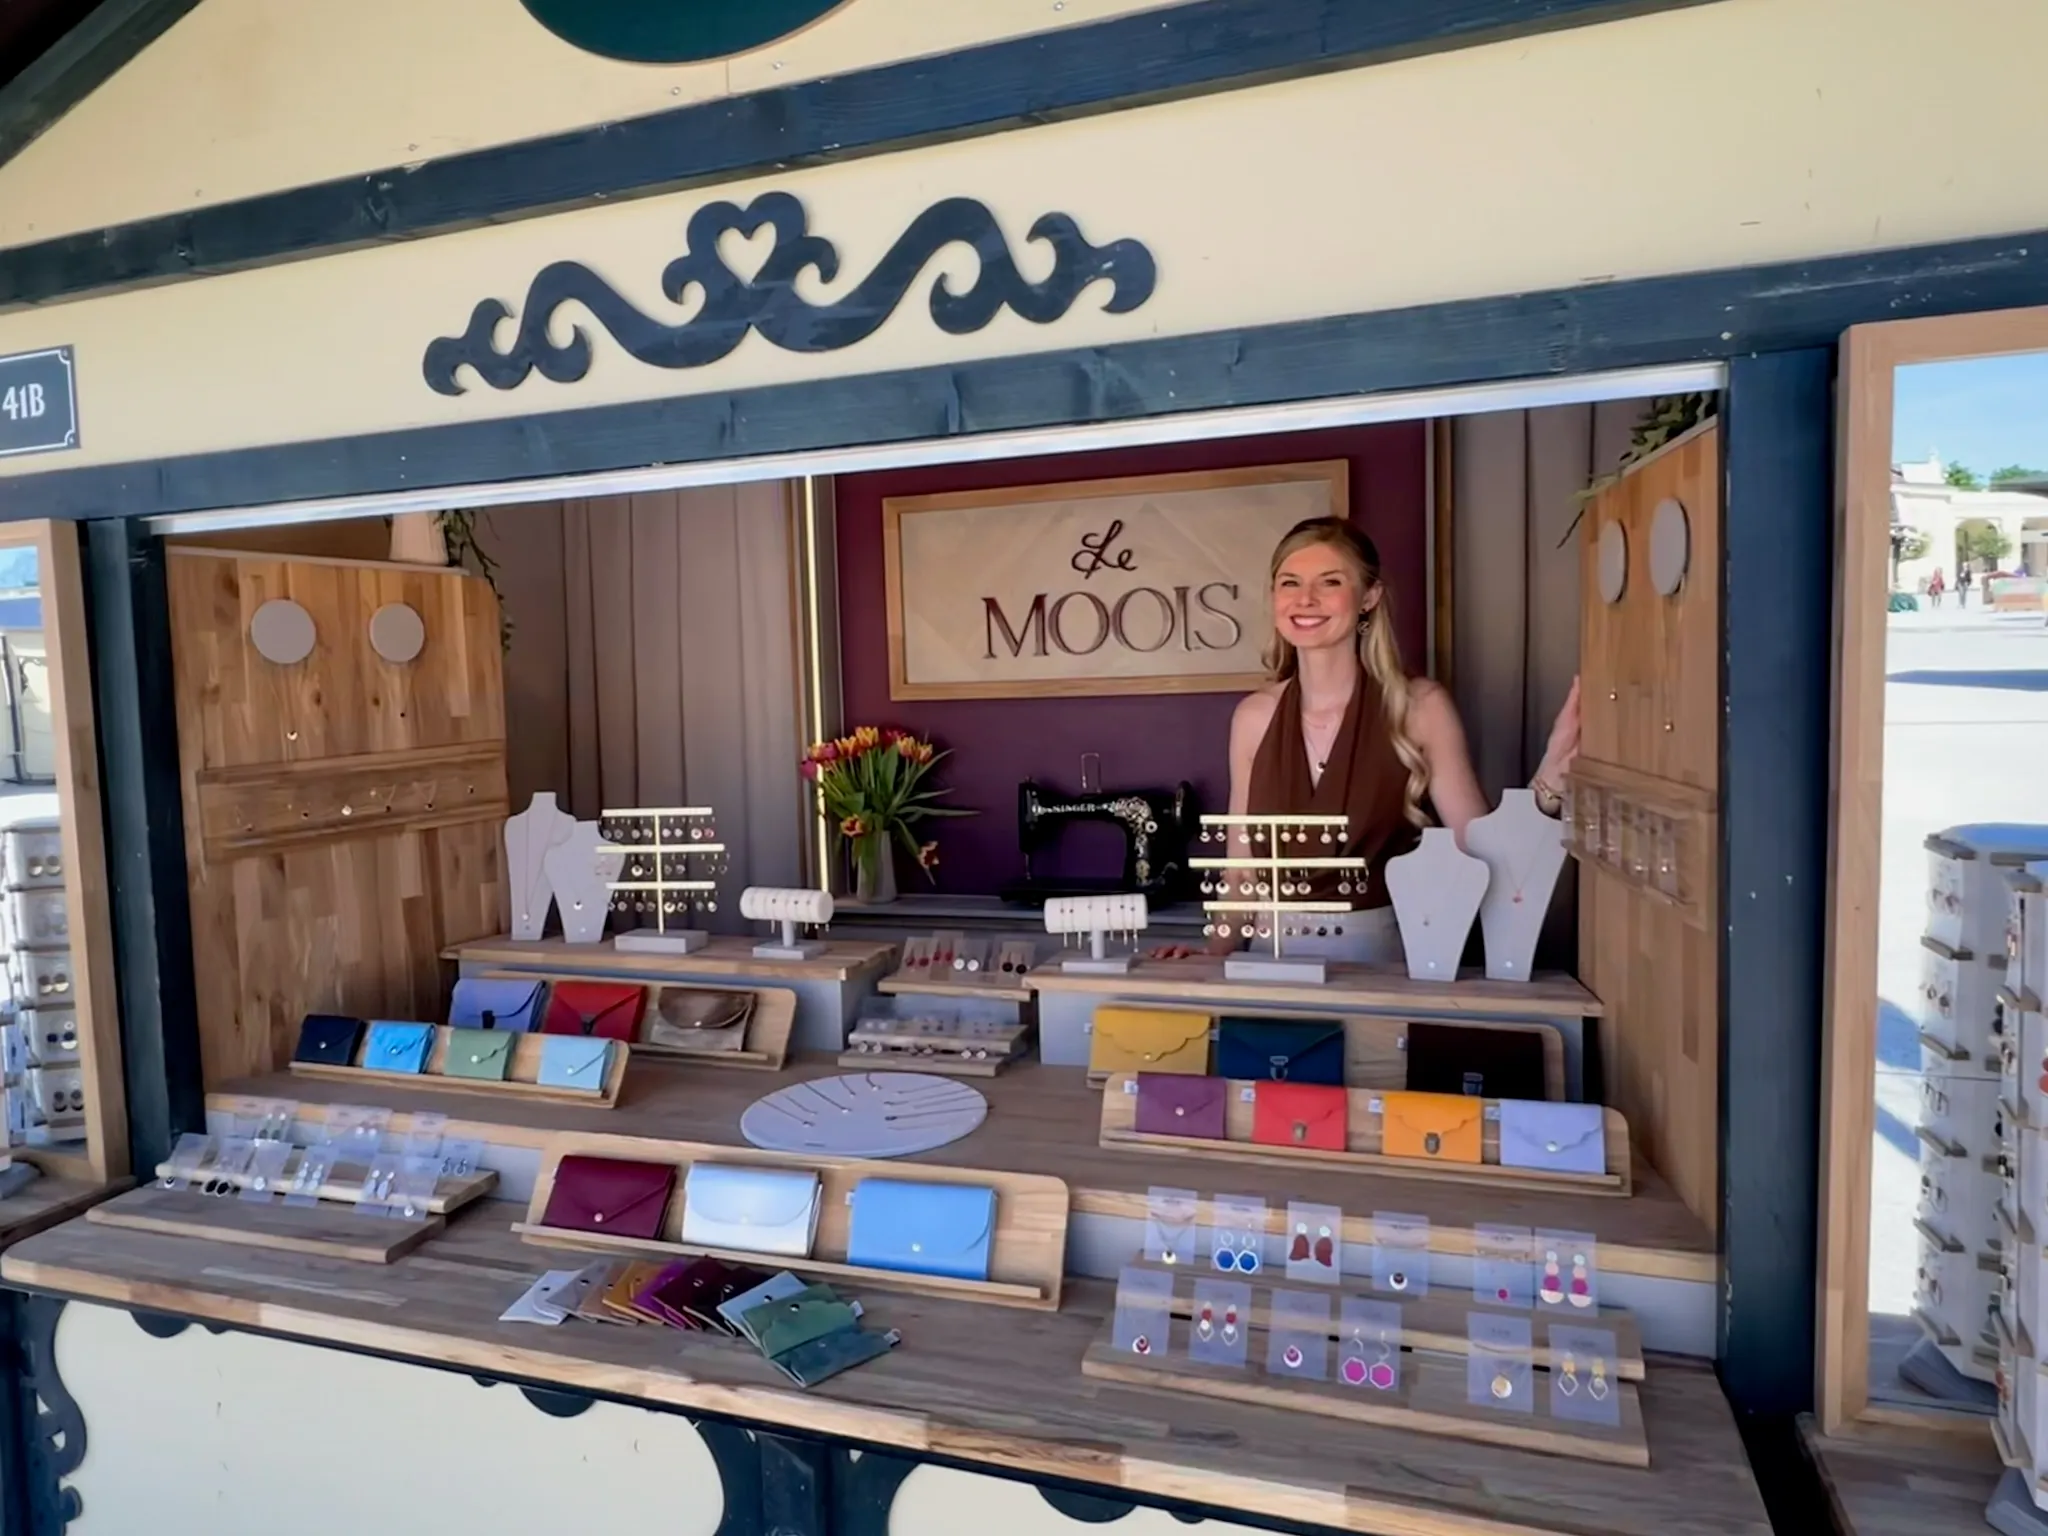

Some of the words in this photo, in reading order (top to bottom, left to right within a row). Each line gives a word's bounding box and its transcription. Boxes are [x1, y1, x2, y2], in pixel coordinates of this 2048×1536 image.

[2, 383, 45, 420] 41B
[1071, 519, 1138, 580] Le
[981, 582, 1243, 660] MOOIS
